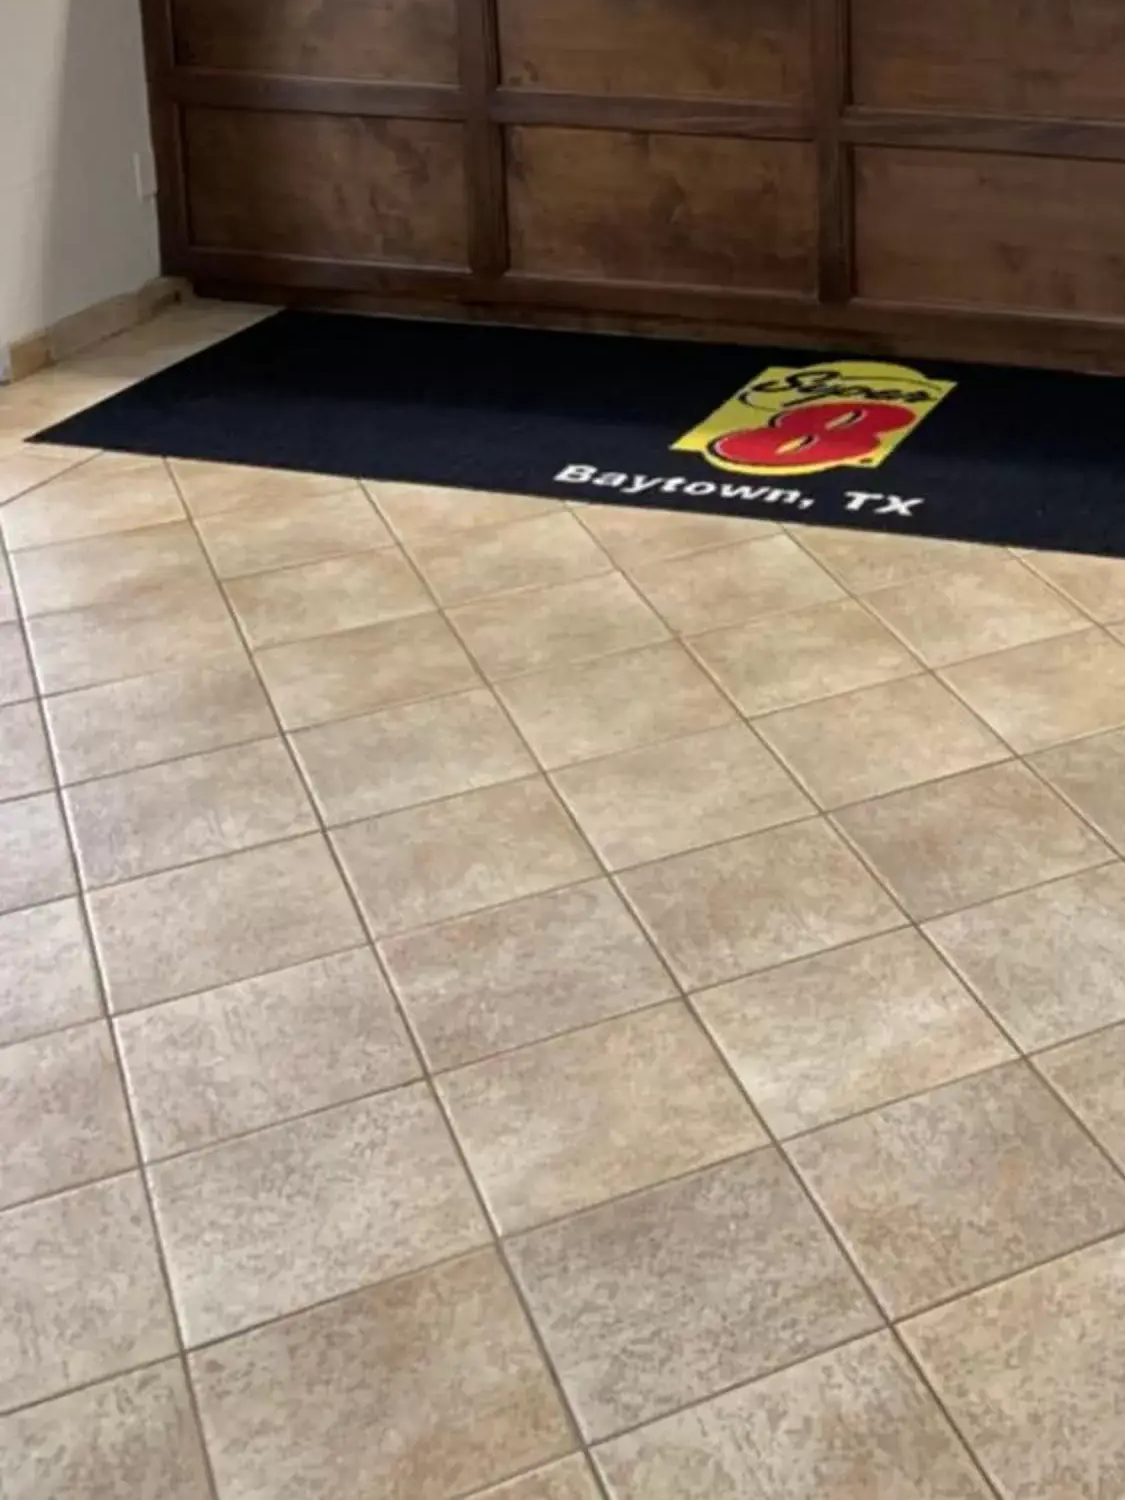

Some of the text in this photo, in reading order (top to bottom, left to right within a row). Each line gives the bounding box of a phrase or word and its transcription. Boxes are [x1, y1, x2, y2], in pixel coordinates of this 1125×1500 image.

[704, 400, 917, 468] 8
[553, 463, 925, 516] Baytown, TX
